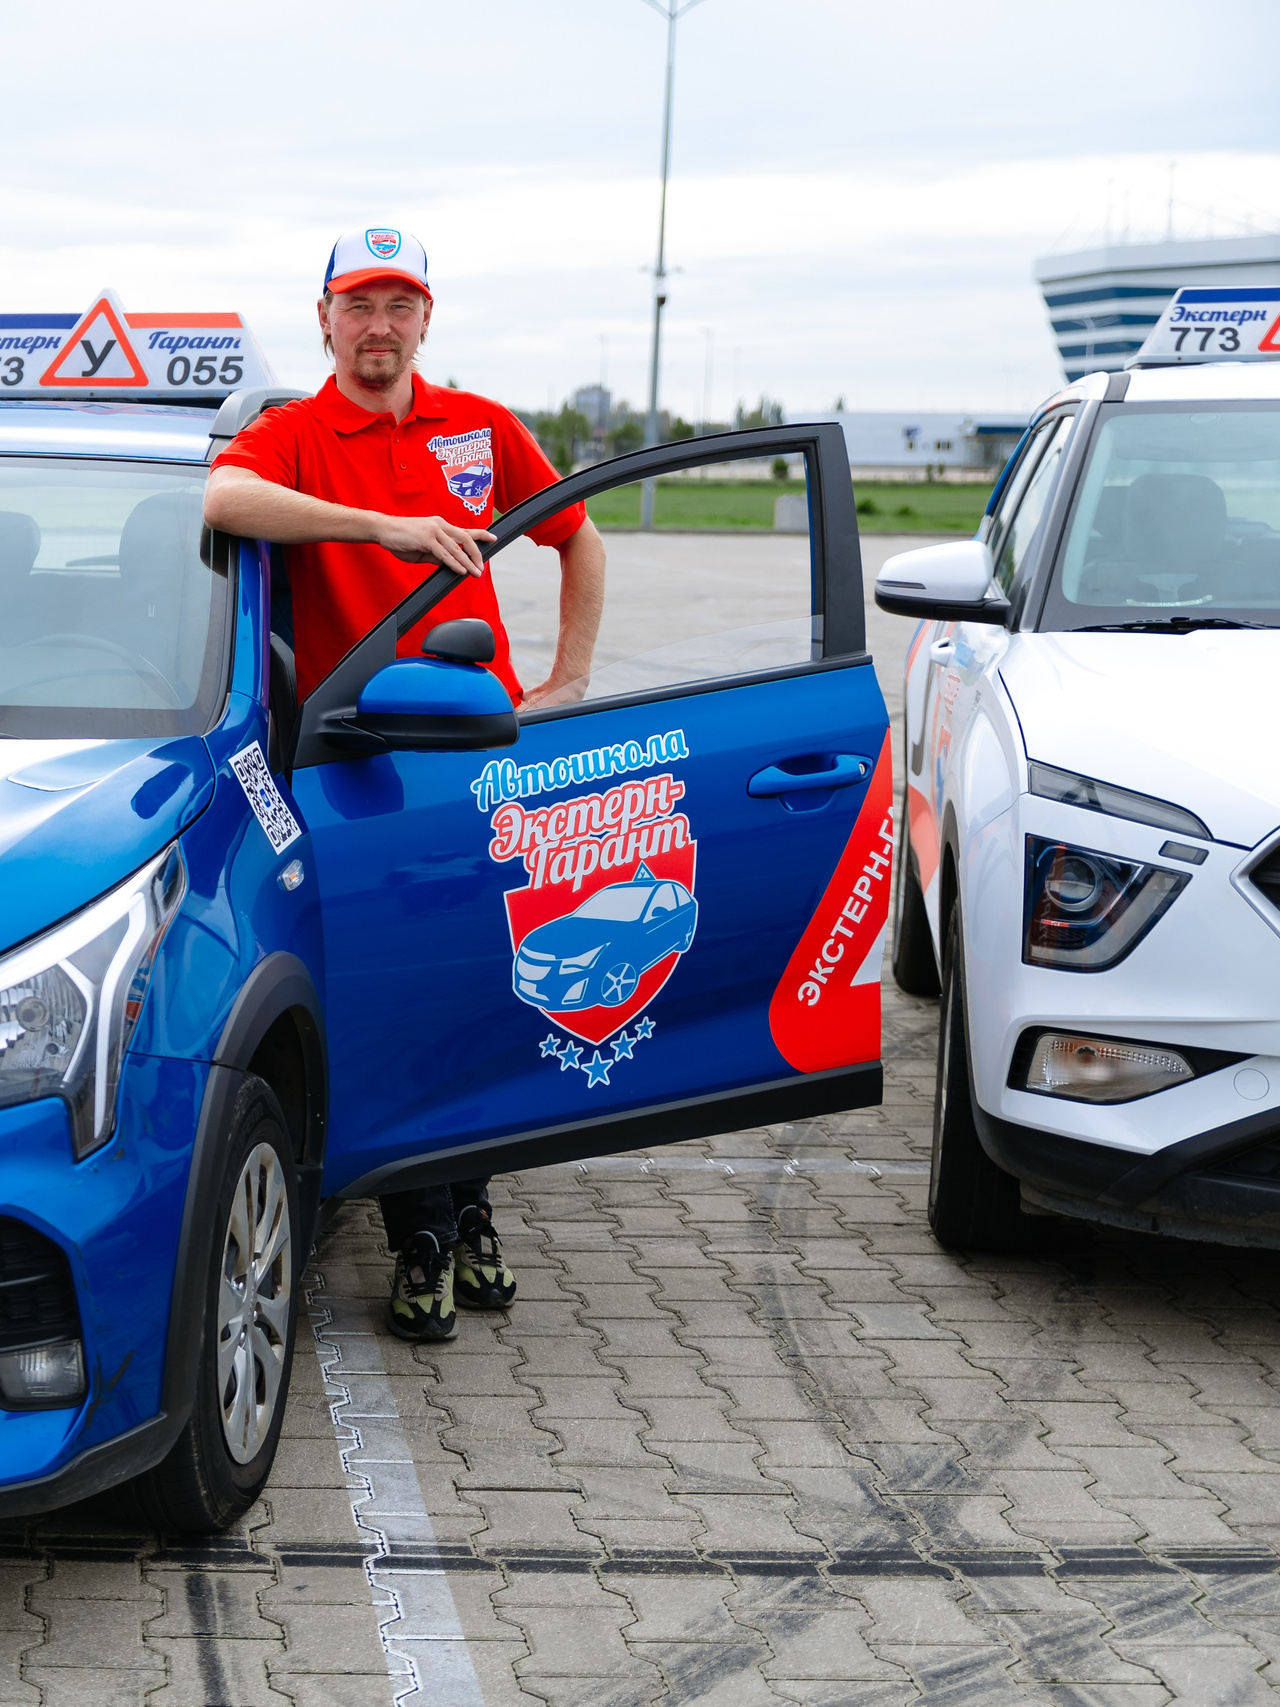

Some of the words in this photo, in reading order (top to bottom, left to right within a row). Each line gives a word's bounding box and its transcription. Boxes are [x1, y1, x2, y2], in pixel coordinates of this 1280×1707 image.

[1169, 305, 1267, 326] Экстерн
[148, 331, 241, 354] Гарант
[1169, 326, 1241, 352] 773
[166, 356, 244, 386] 055
[427, 429, 491, 451] Автошкола
[447, 450, 491, 467] Гарант
[472, 730, 688, 811] Автошкола
[493, 776, 683, 859] Экстерн-
[529, 818, 688, 892] Гарант
